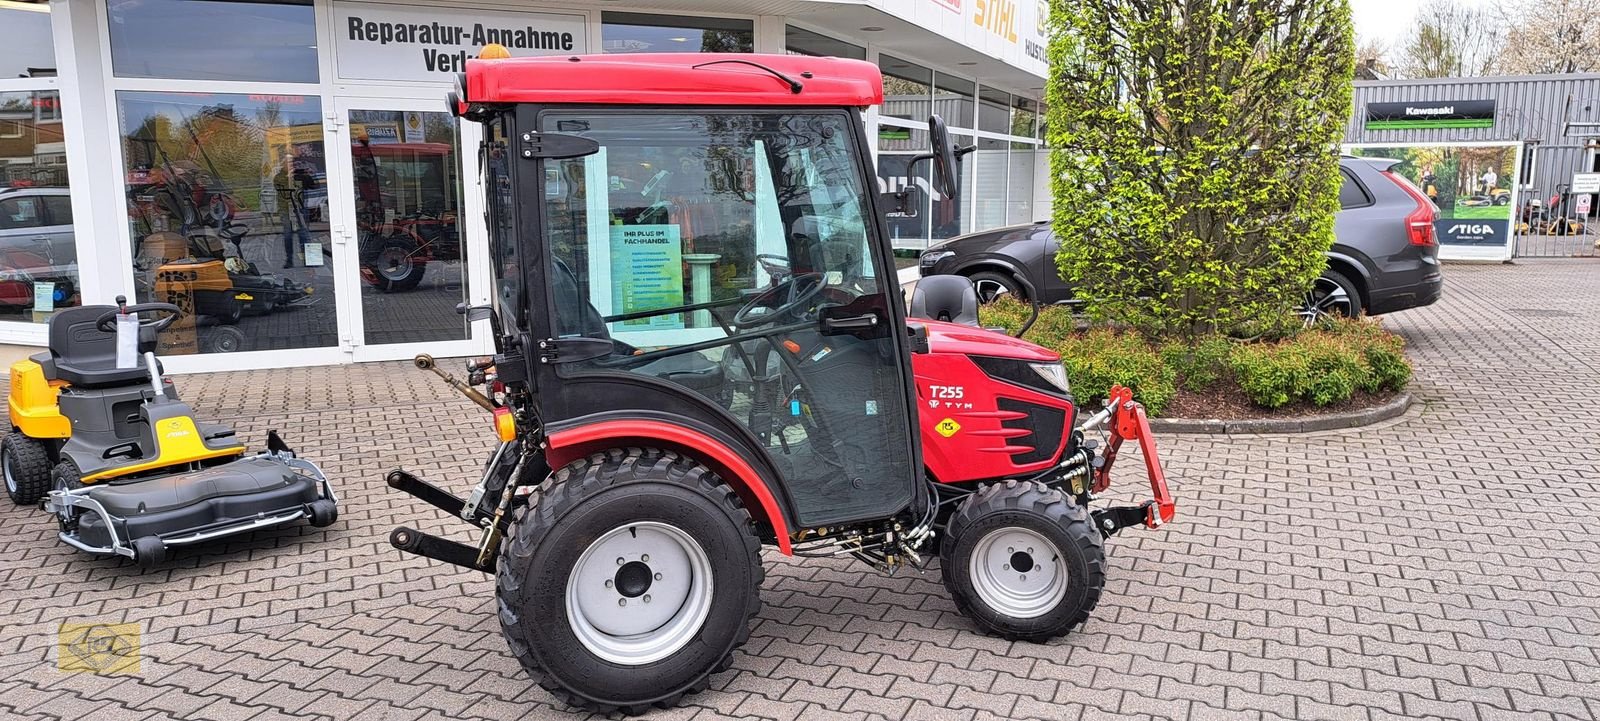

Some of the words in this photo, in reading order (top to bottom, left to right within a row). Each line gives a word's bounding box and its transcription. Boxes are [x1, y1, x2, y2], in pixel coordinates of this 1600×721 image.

[974, 0, 1017, 44] STIHL
[348, 16, 573, 50] Reparatur-Annahme
[1405, 106, 1454, 115] Kawasaki
[1447, 224, 1494, 234] STIGA
[929, 385, 964, 398] T255
